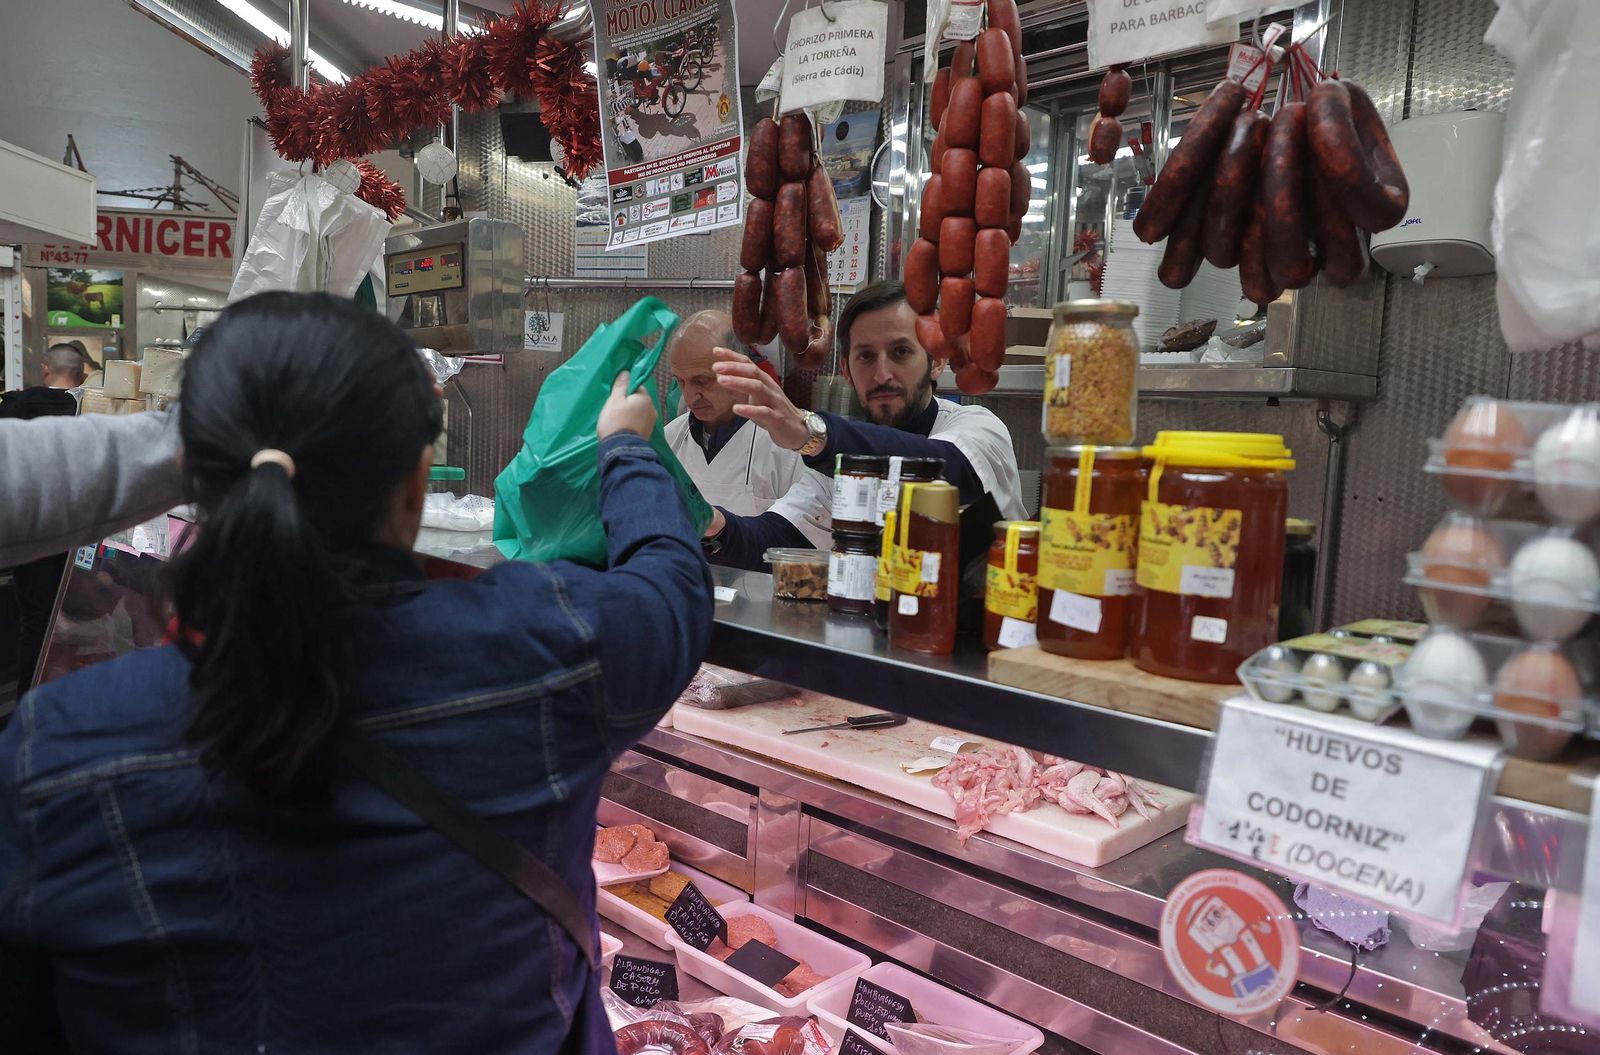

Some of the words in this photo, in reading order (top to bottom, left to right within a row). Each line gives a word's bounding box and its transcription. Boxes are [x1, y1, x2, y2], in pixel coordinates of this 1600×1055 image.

[605, 0, 658, 37] MOTOS
[1110, 17, 1146, 34] PARA
[1149, 2, 1205, 26] BARBAC
[789, 33, 826, 51] CHORIZO
[828, 29, 874, 41] PRIMERA
[798, 55, 809, 65] LA
[811, 46, 857, 62] TORREÑA
[820, 68, 832, 78] de
[834, 65, 864, 77] Cádiz)
[44, 214, 232, 258] RNICER
[852, 246, 859, 256] 15
[850, 258, 858, 268] 22
[849, 271, 857, 281] 29
[1310, 772, 1349, 799] DE
[1285, 841, 1426, 907] (DOCENA)
[614, 979, 629, 991] DE
[630, 982, 660, 995] POLLO
